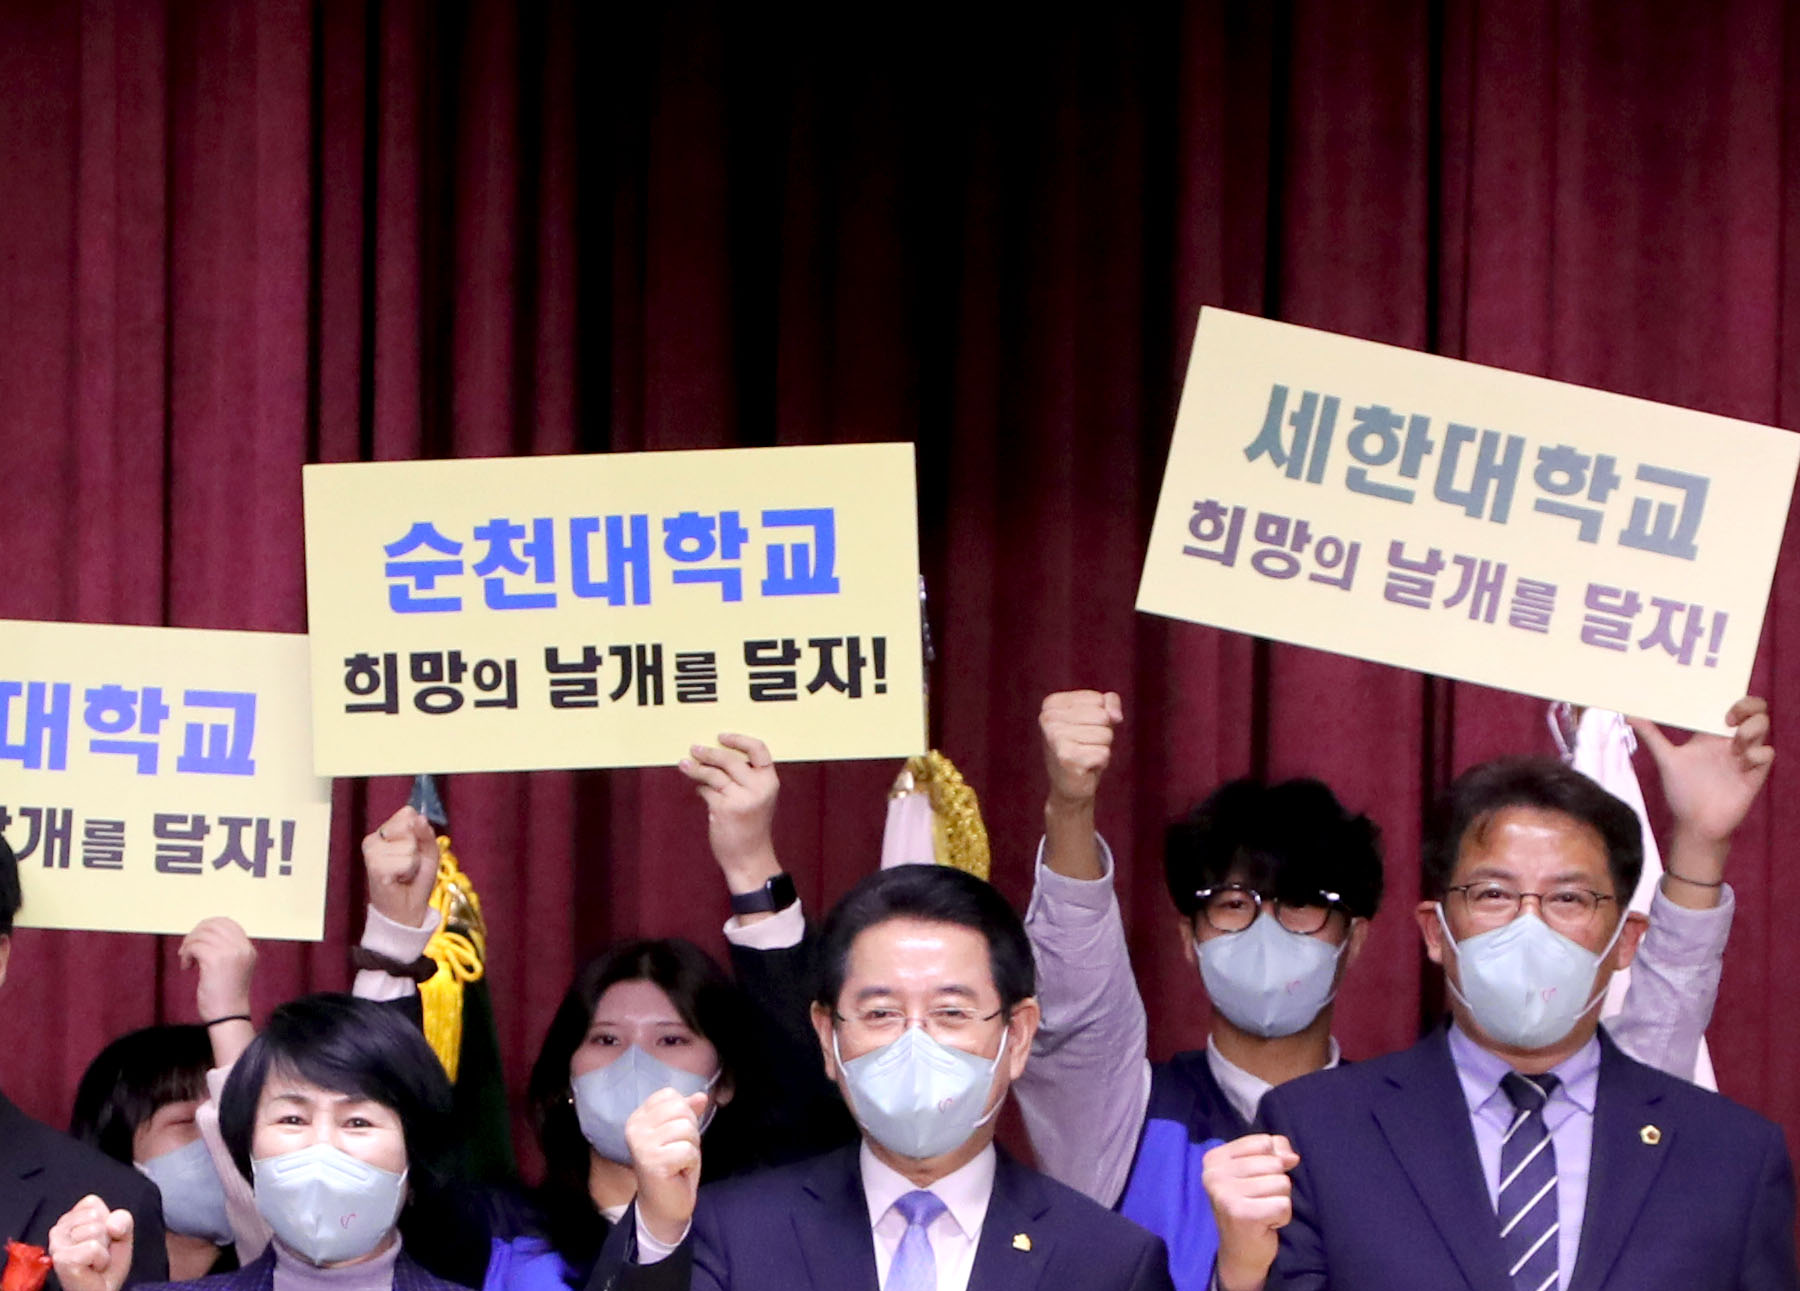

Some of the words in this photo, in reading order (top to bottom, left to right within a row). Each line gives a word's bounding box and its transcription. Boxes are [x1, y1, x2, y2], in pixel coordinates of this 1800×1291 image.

[1244, 383, 1710, 561] 세한대학교
[383, 506, 840, 614] 순천대학교
[1182, 499, 1360, 592] 희망의
[1384, 541, 1559, 634] 날개를
[1580, 582, 1729, 668] 달자!
[344, 648, 517, 714] 희망의
[546, 642, 719, 710] 날개를
[744, 636, 887, 704] 달자!
[153, 806, 295, 878] 달자!
